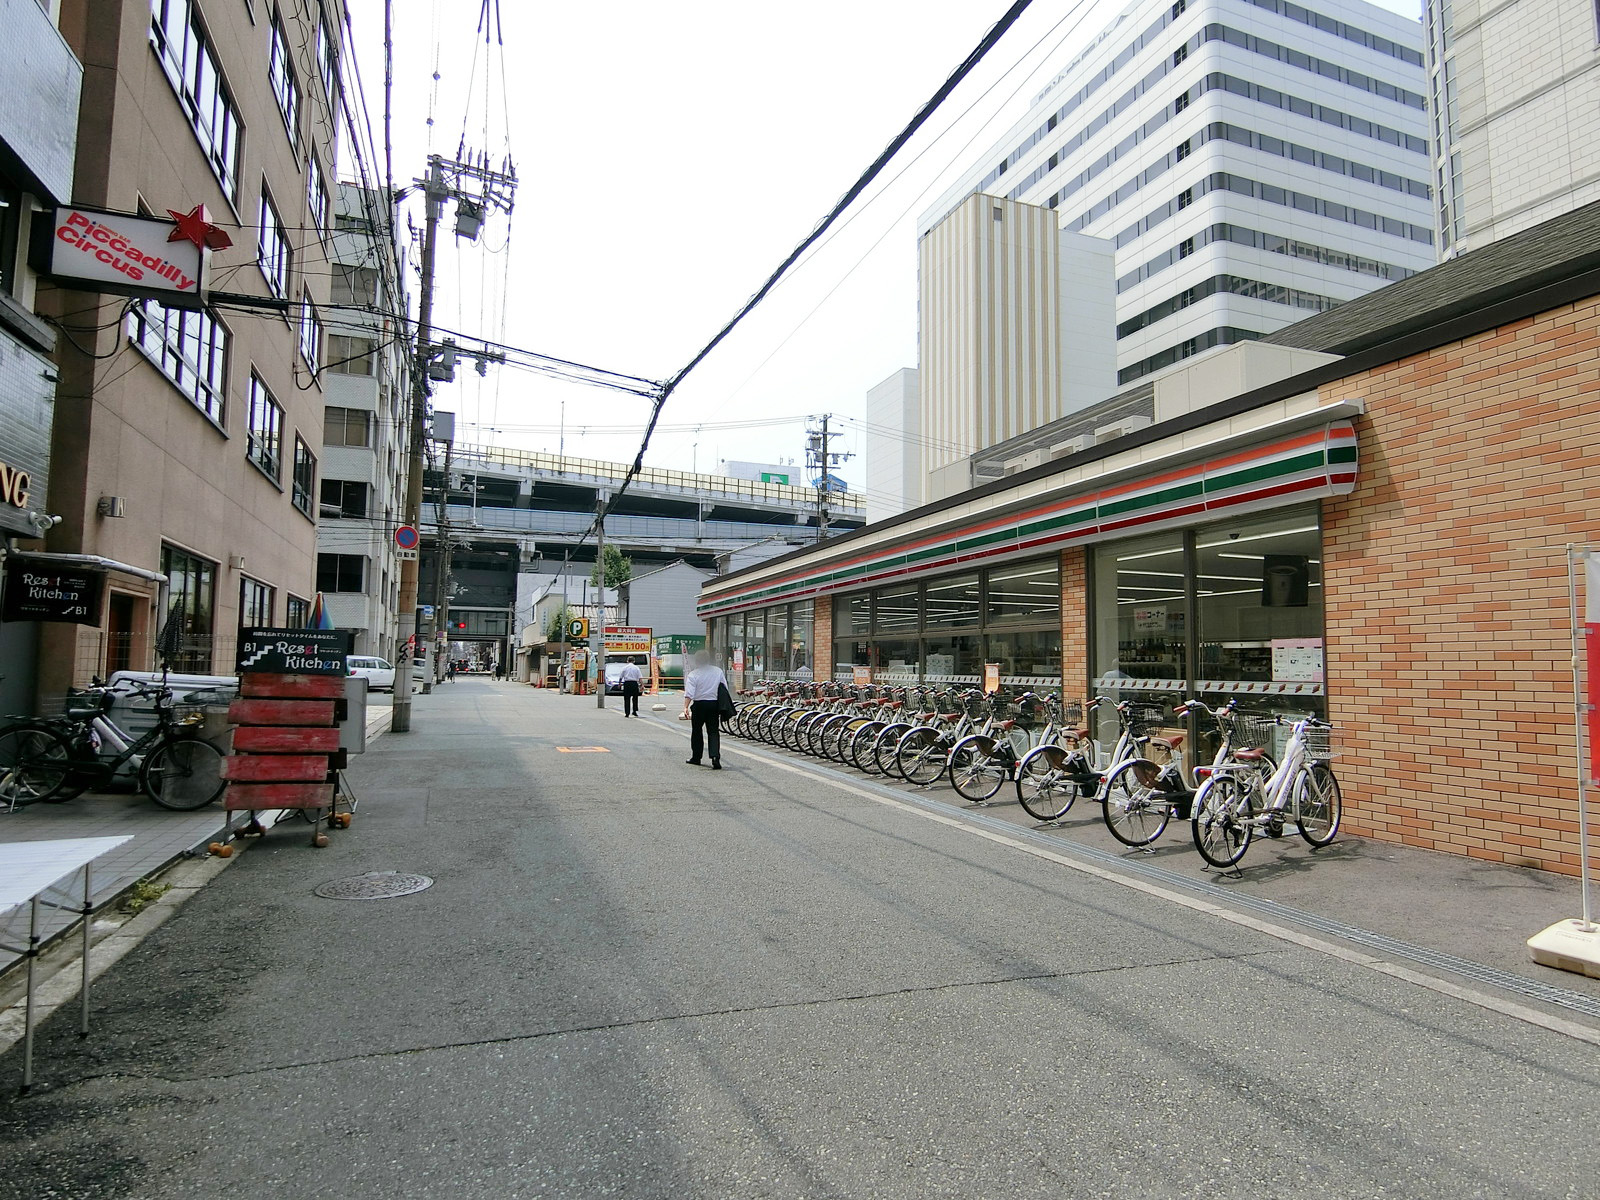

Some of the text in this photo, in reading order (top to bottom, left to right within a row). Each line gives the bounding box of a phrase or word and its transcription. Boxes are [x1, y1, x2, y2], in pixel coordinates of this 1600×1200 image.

[56, 225, 145, 281] Circus
[66, 212, 196, 290] Piccadilly
[22, 573, 61, 586] Reset
[29, 587, 79, 601] Kitchen
[75, 606, 87, 615] B1
[572, 621, 582, 635] P
[243, 642, 257, 652] B1
[275, 641, 319, 655] Reset
[285, 655, 341, 670] Kitchen
